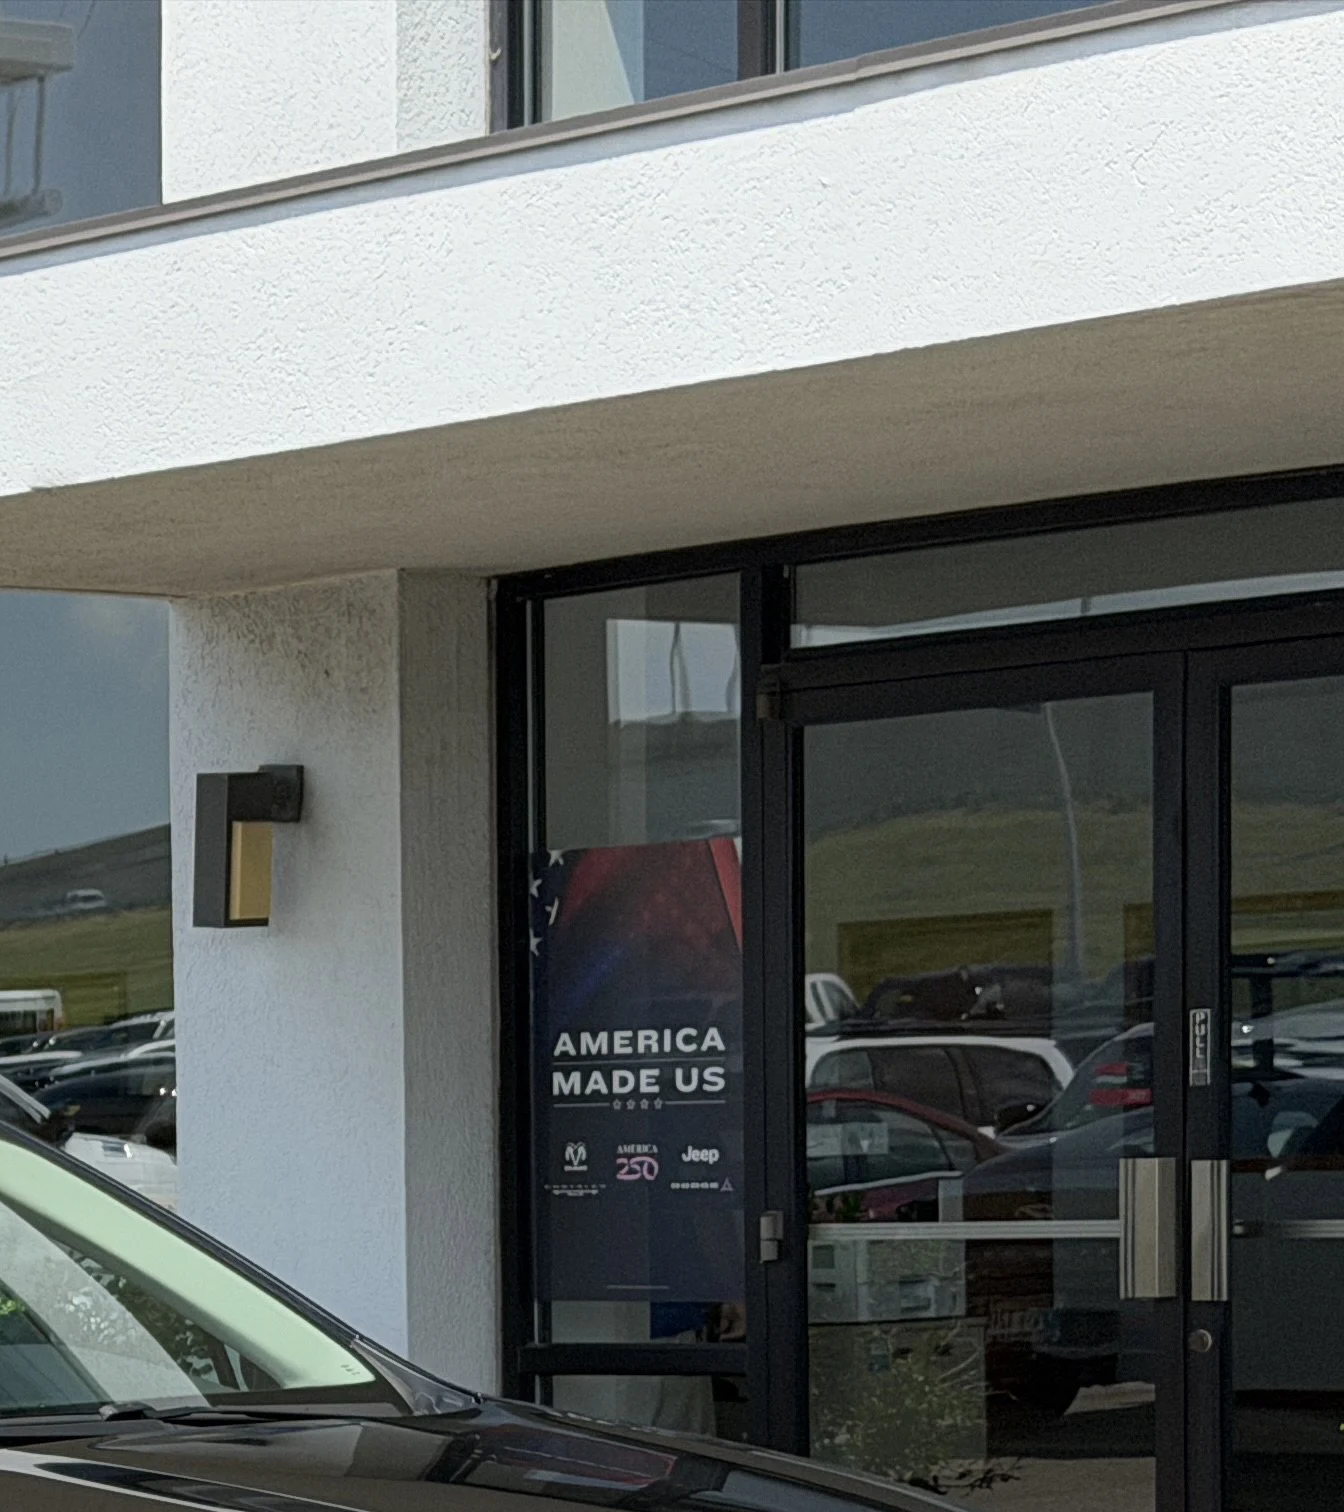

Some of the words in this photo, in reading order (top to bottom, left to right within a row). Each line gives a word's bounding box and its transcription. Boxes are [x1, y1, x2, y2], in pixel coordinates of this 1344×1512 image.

[553, 1027, 726, 1057] AMERICA
[1195, 1011, 1206, 1058] PULL
[552, 1068, 660, 1096] MADE
[675, 1066, 726, 1093] US
[616, 1144, 659, 1155] AMERICA
[681, 1145, 720, 1164] Jeep
[616, 1156, 660, 1181] 250
